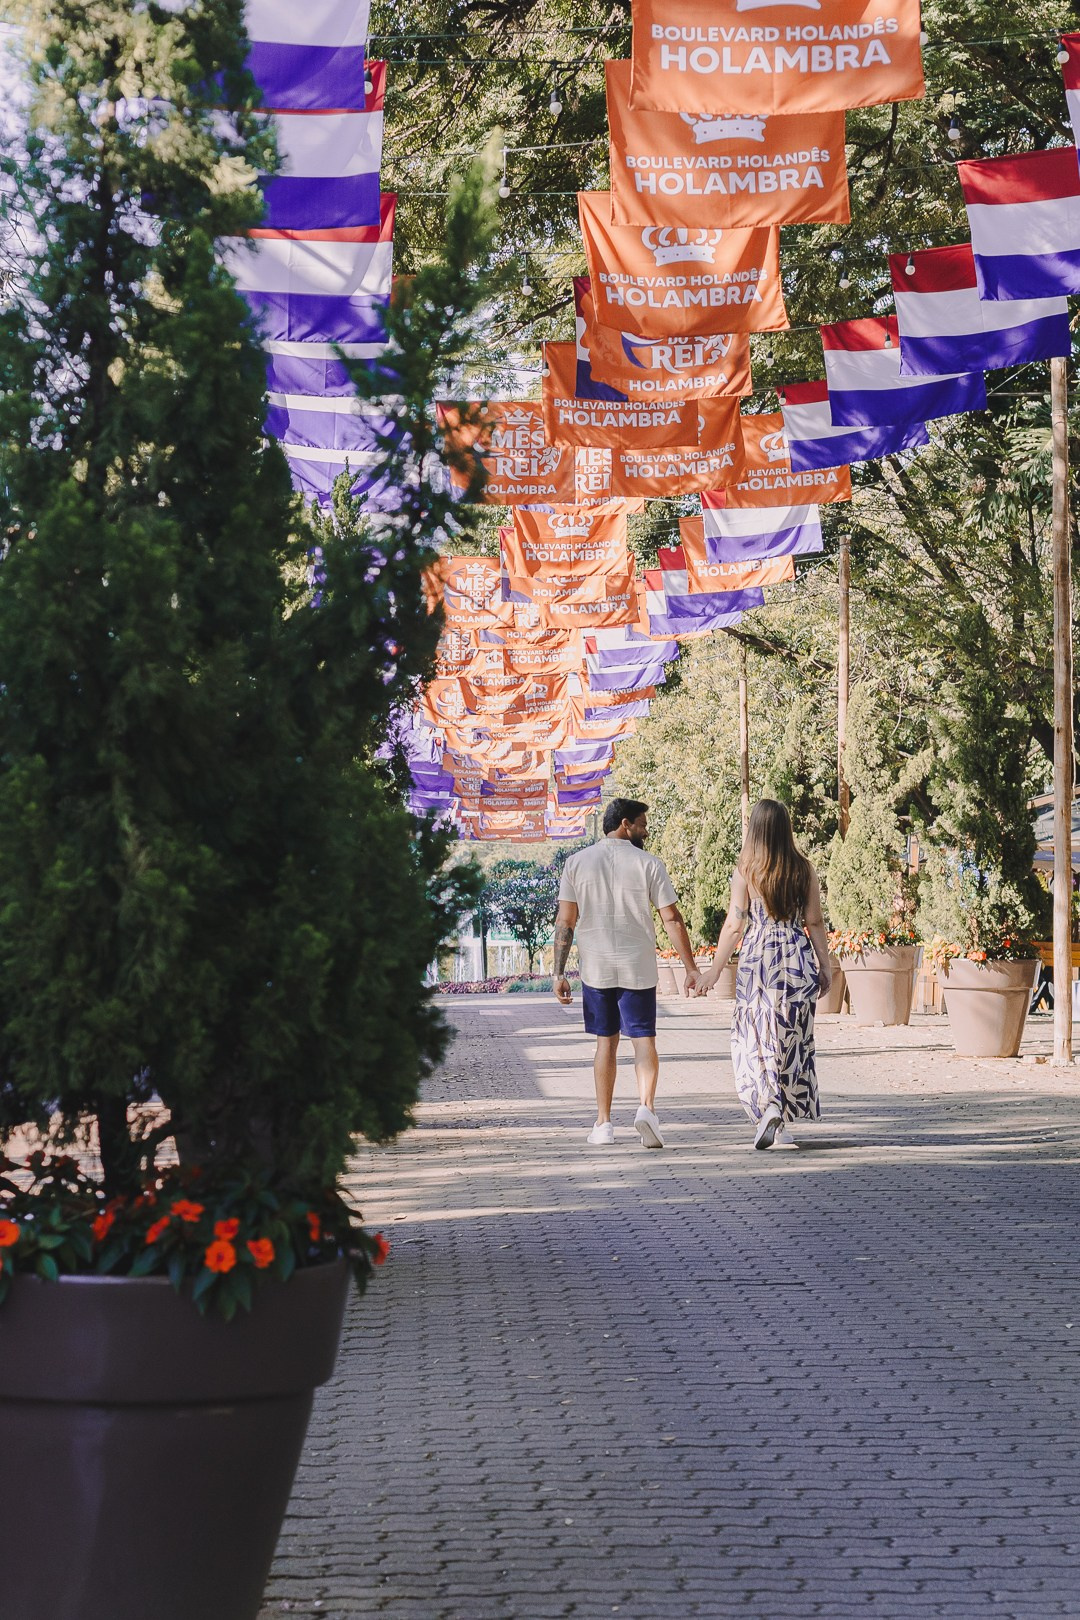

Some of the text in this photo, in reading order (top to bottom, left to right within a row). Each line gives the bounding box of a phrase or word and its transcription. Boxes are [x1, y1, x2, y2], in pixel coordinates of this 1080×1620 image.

[651, 17, 899, 42] BOULEVARD HOLANDÊS
[660, 39, 891, 74] HOLAMBRA
[625, 146, 830, 169] BOULEVARD HOLANDÊS
[634, 166, 824, 195] HOLAMBRA
[599, 268, 768, 287] BOULEVARD HOLANDÊS
[606, 284, 763, 308] HOLAMBRA
[651, 344, 704, 374] REI
[629, 373, 728, 392] HOLAMBRA
[553, 399, 621, 411] BOULEVARD
[558, 409, 682, 428] HOLAMBRA
[490, 425, 545, 449] MÊS
[509, 449, 526, 457] DO
[620, 442, 736, 463] BOULEVARD HOLANDÊS
[496, 457, 541, 480] REI
[583, 466, 599, 474] DO
[624, 454, 734, 478] HOLAMBRA
[575, 473, 611, 494] REI
[522, 542, 573, 550] BOULEVARD
[525, 548, 618, 562] HOLAMBRA
[455, 574, 496, 591] MÊS
[532, 587, 594, 597] HOLAMBRA
[469, 590, 482, 598] DO
[460, 596, 491, 614] REI
[550, 601, 629, 615] HOLAMBRA
[447, 614, 502, 623] HOLAMBRA
[506, 629, 558, 638] HOLAMBRA
